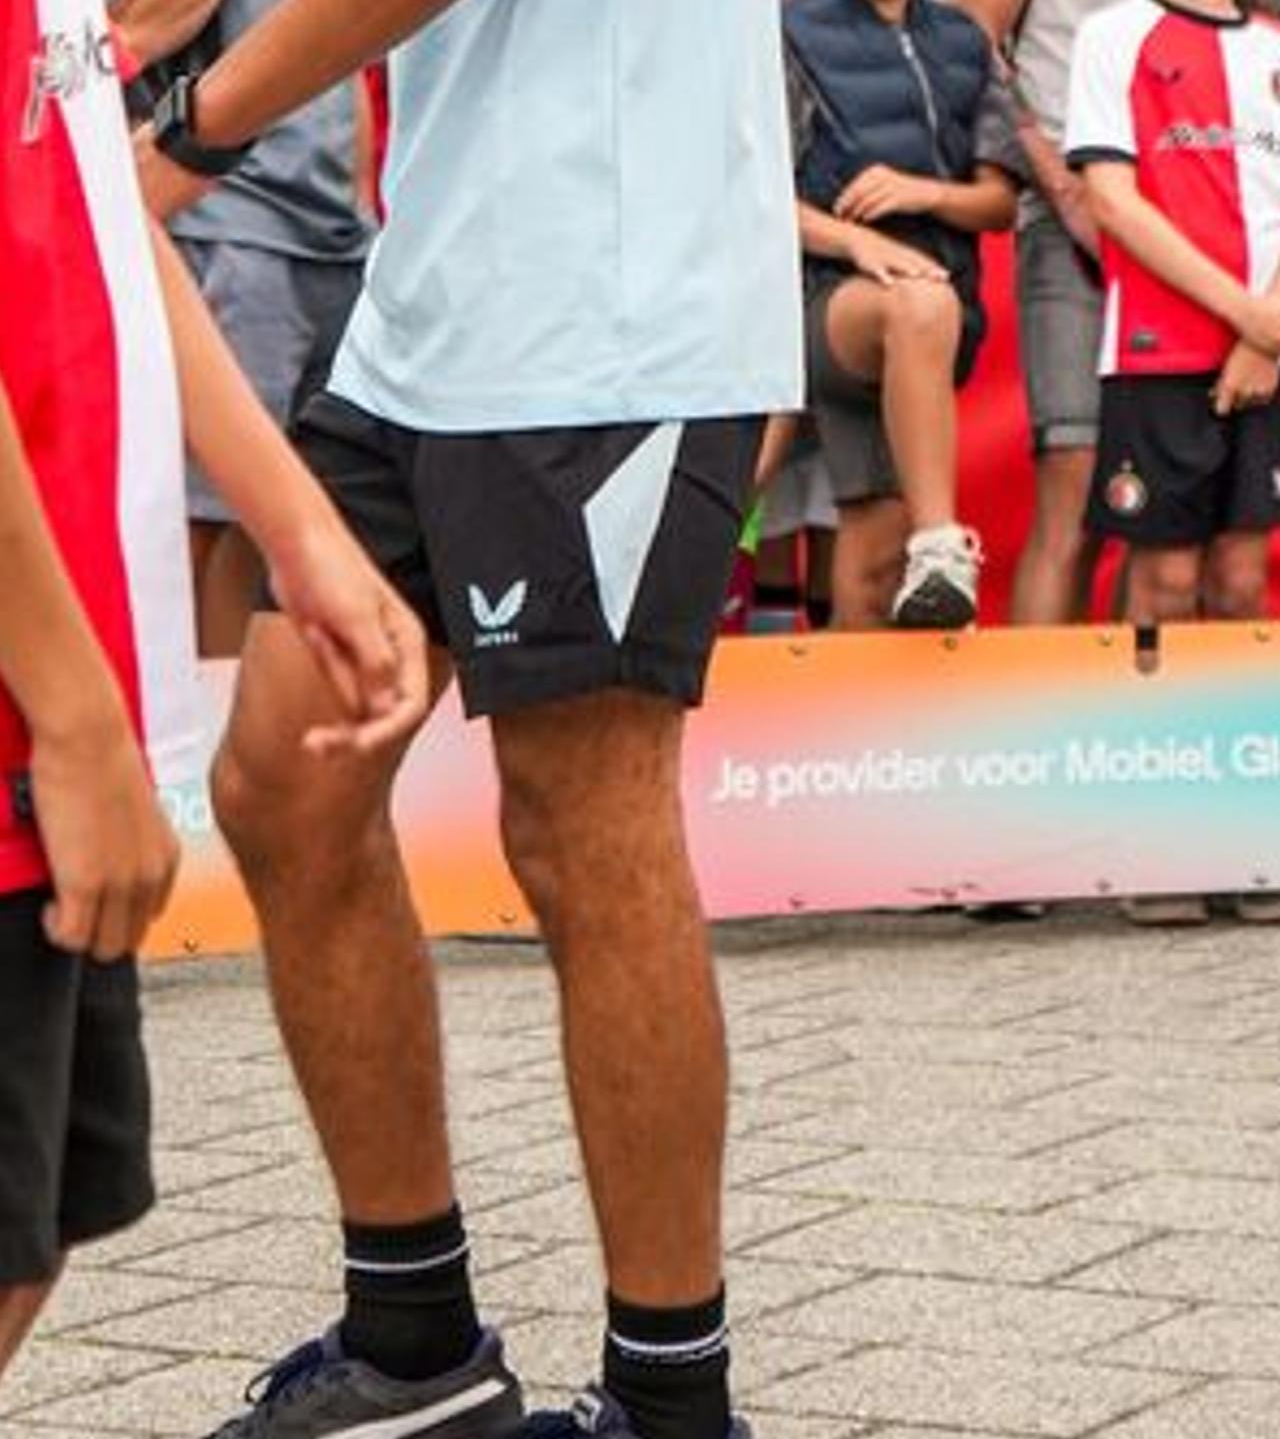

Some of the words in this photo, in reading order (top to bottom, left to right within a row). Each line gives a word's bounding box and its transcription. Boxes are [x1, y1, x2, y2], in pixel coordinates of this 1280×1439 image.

[711, 756, 759, 803] Je
[766, 747, 949, 808] provider
[957, 751, 1056, 787] voor
